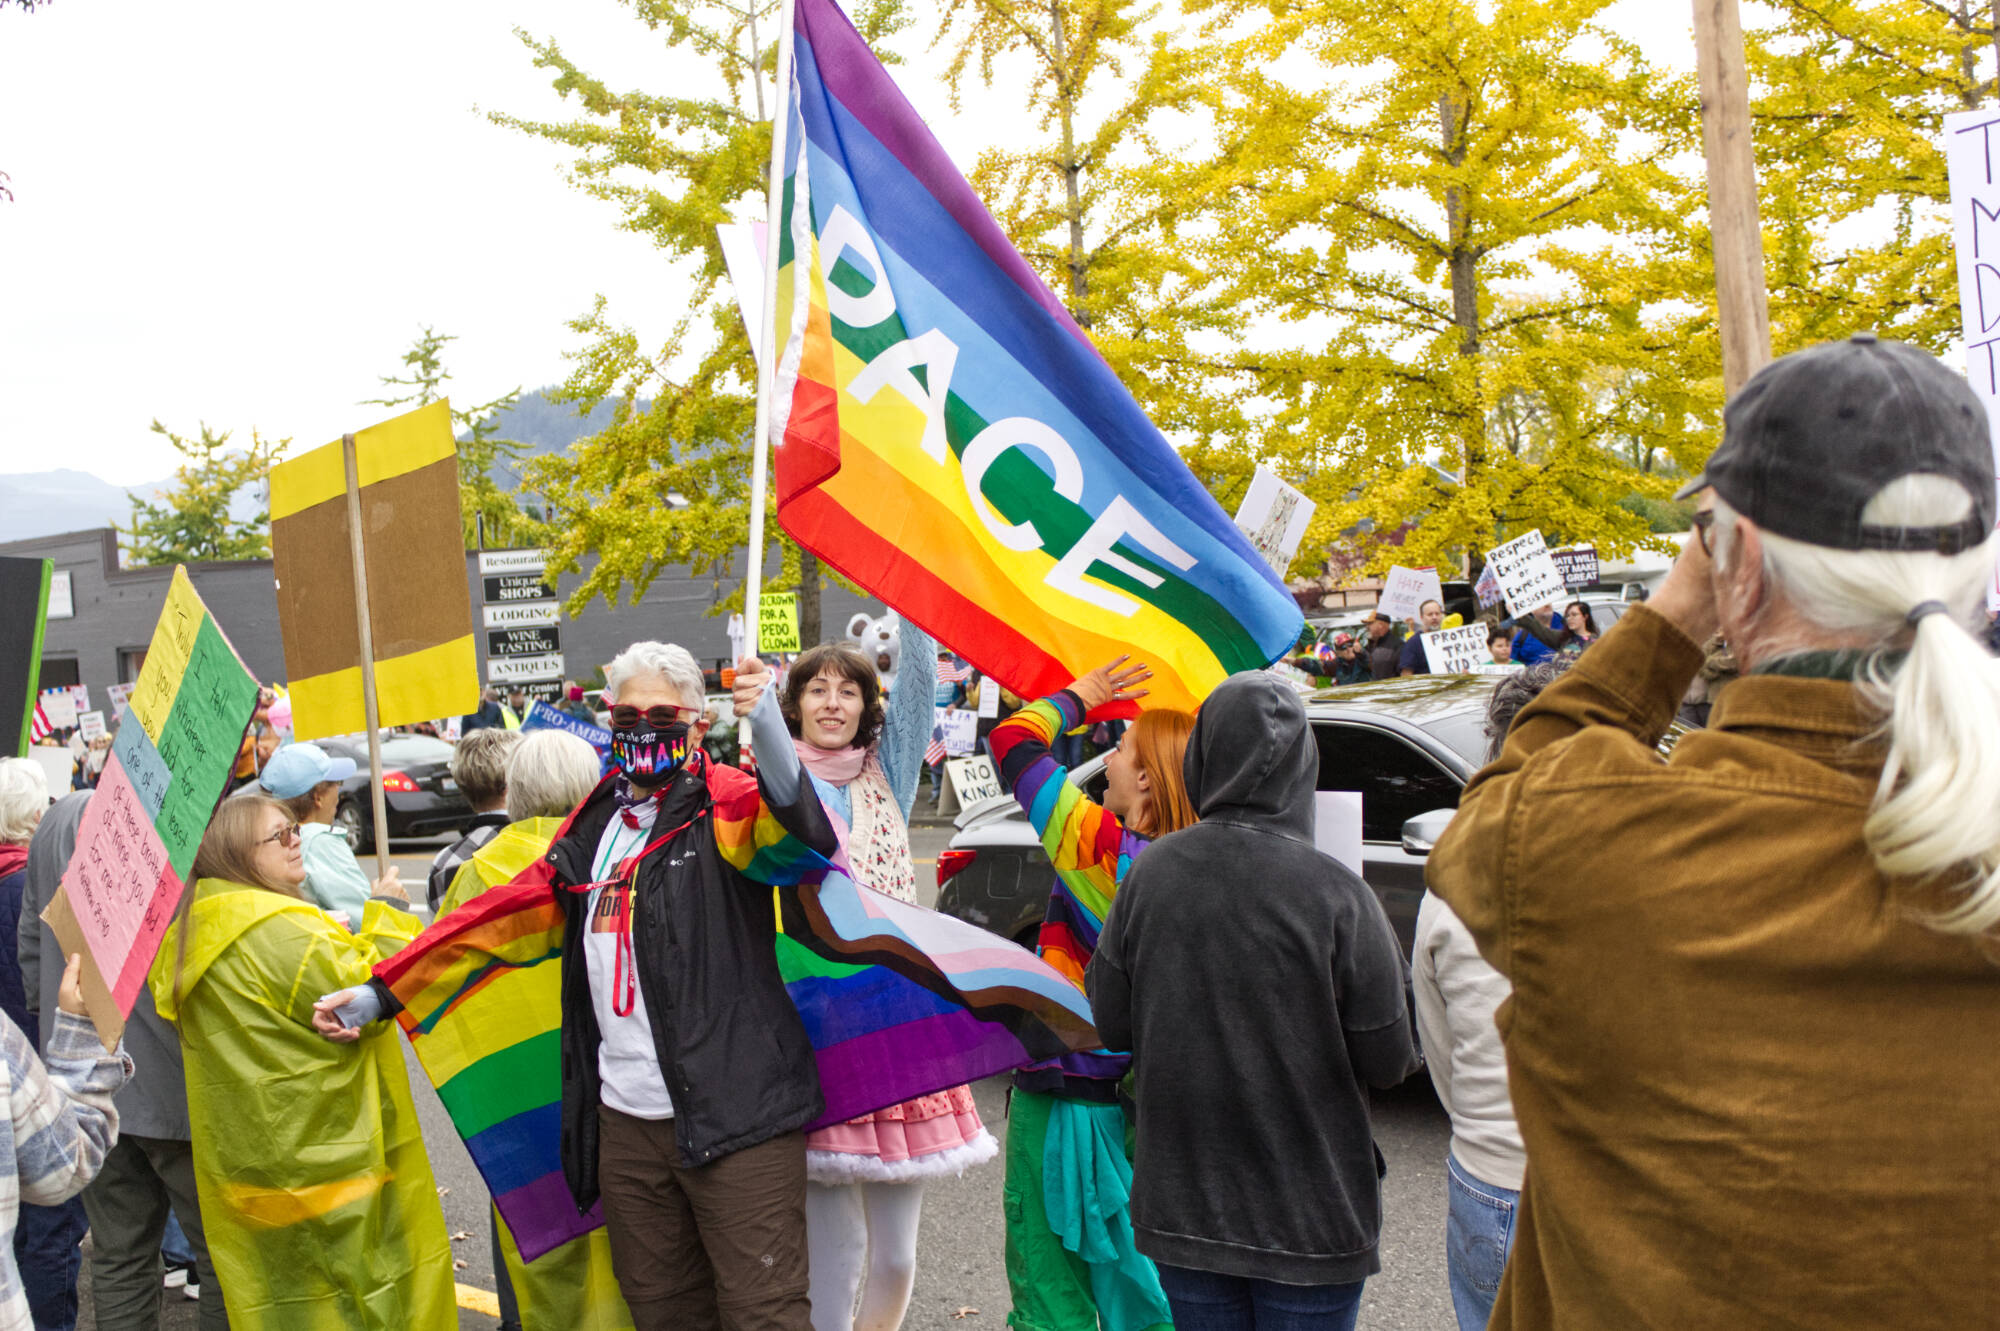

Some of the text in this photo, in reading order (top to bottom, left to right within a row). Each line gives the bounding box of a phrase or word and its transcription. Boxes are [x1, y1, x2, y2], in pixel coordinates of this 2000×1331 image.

[818, 203, 1199, 618] PACE
[1573, 553, 1596, 564] WILL
[1519, 568, 1529, 578] or
[1557, 562, 1597, 575] OT MAKE
[499, 576, 539, 589] Unique
[1566, 572, 1598, 583] GREAT
[499, 586, 542, 600] SHOPS
[766, 595, 794, 606] CROWN
[492, 607, 552, 622] LODGING
[760, 609, 787, 620] FOR A
[507, 630, 541, 642] WINE
[761, 623, 789, 636] PEDO
[1430, 625, 1487, 647] PROTECT
[496, 640, 552, 653] TASTING
[762, 636, 797, 650] CLOWN
[1442, 639, 1485, 659] TRANS
[494, 659, 559, 674] ANTIQUES
[1444, 654, 1480, 674] KIDS
[529, 683, 560, 693] Center
[211, 676, 230, 720] tell
[175, 699, 207, 762] whatever
[138, 710, 195, 800] you did for
[613, 737, 685, 774] HUMAN
[964, 764, 990, 782] NO
[127, 747, 188, 850] one of the least
[960, 782, 1001, 803] KINGS
[140, 832, 168, 898] brothers
[127, 870, 145, 907] you
[146, 905, 160, 932] did
